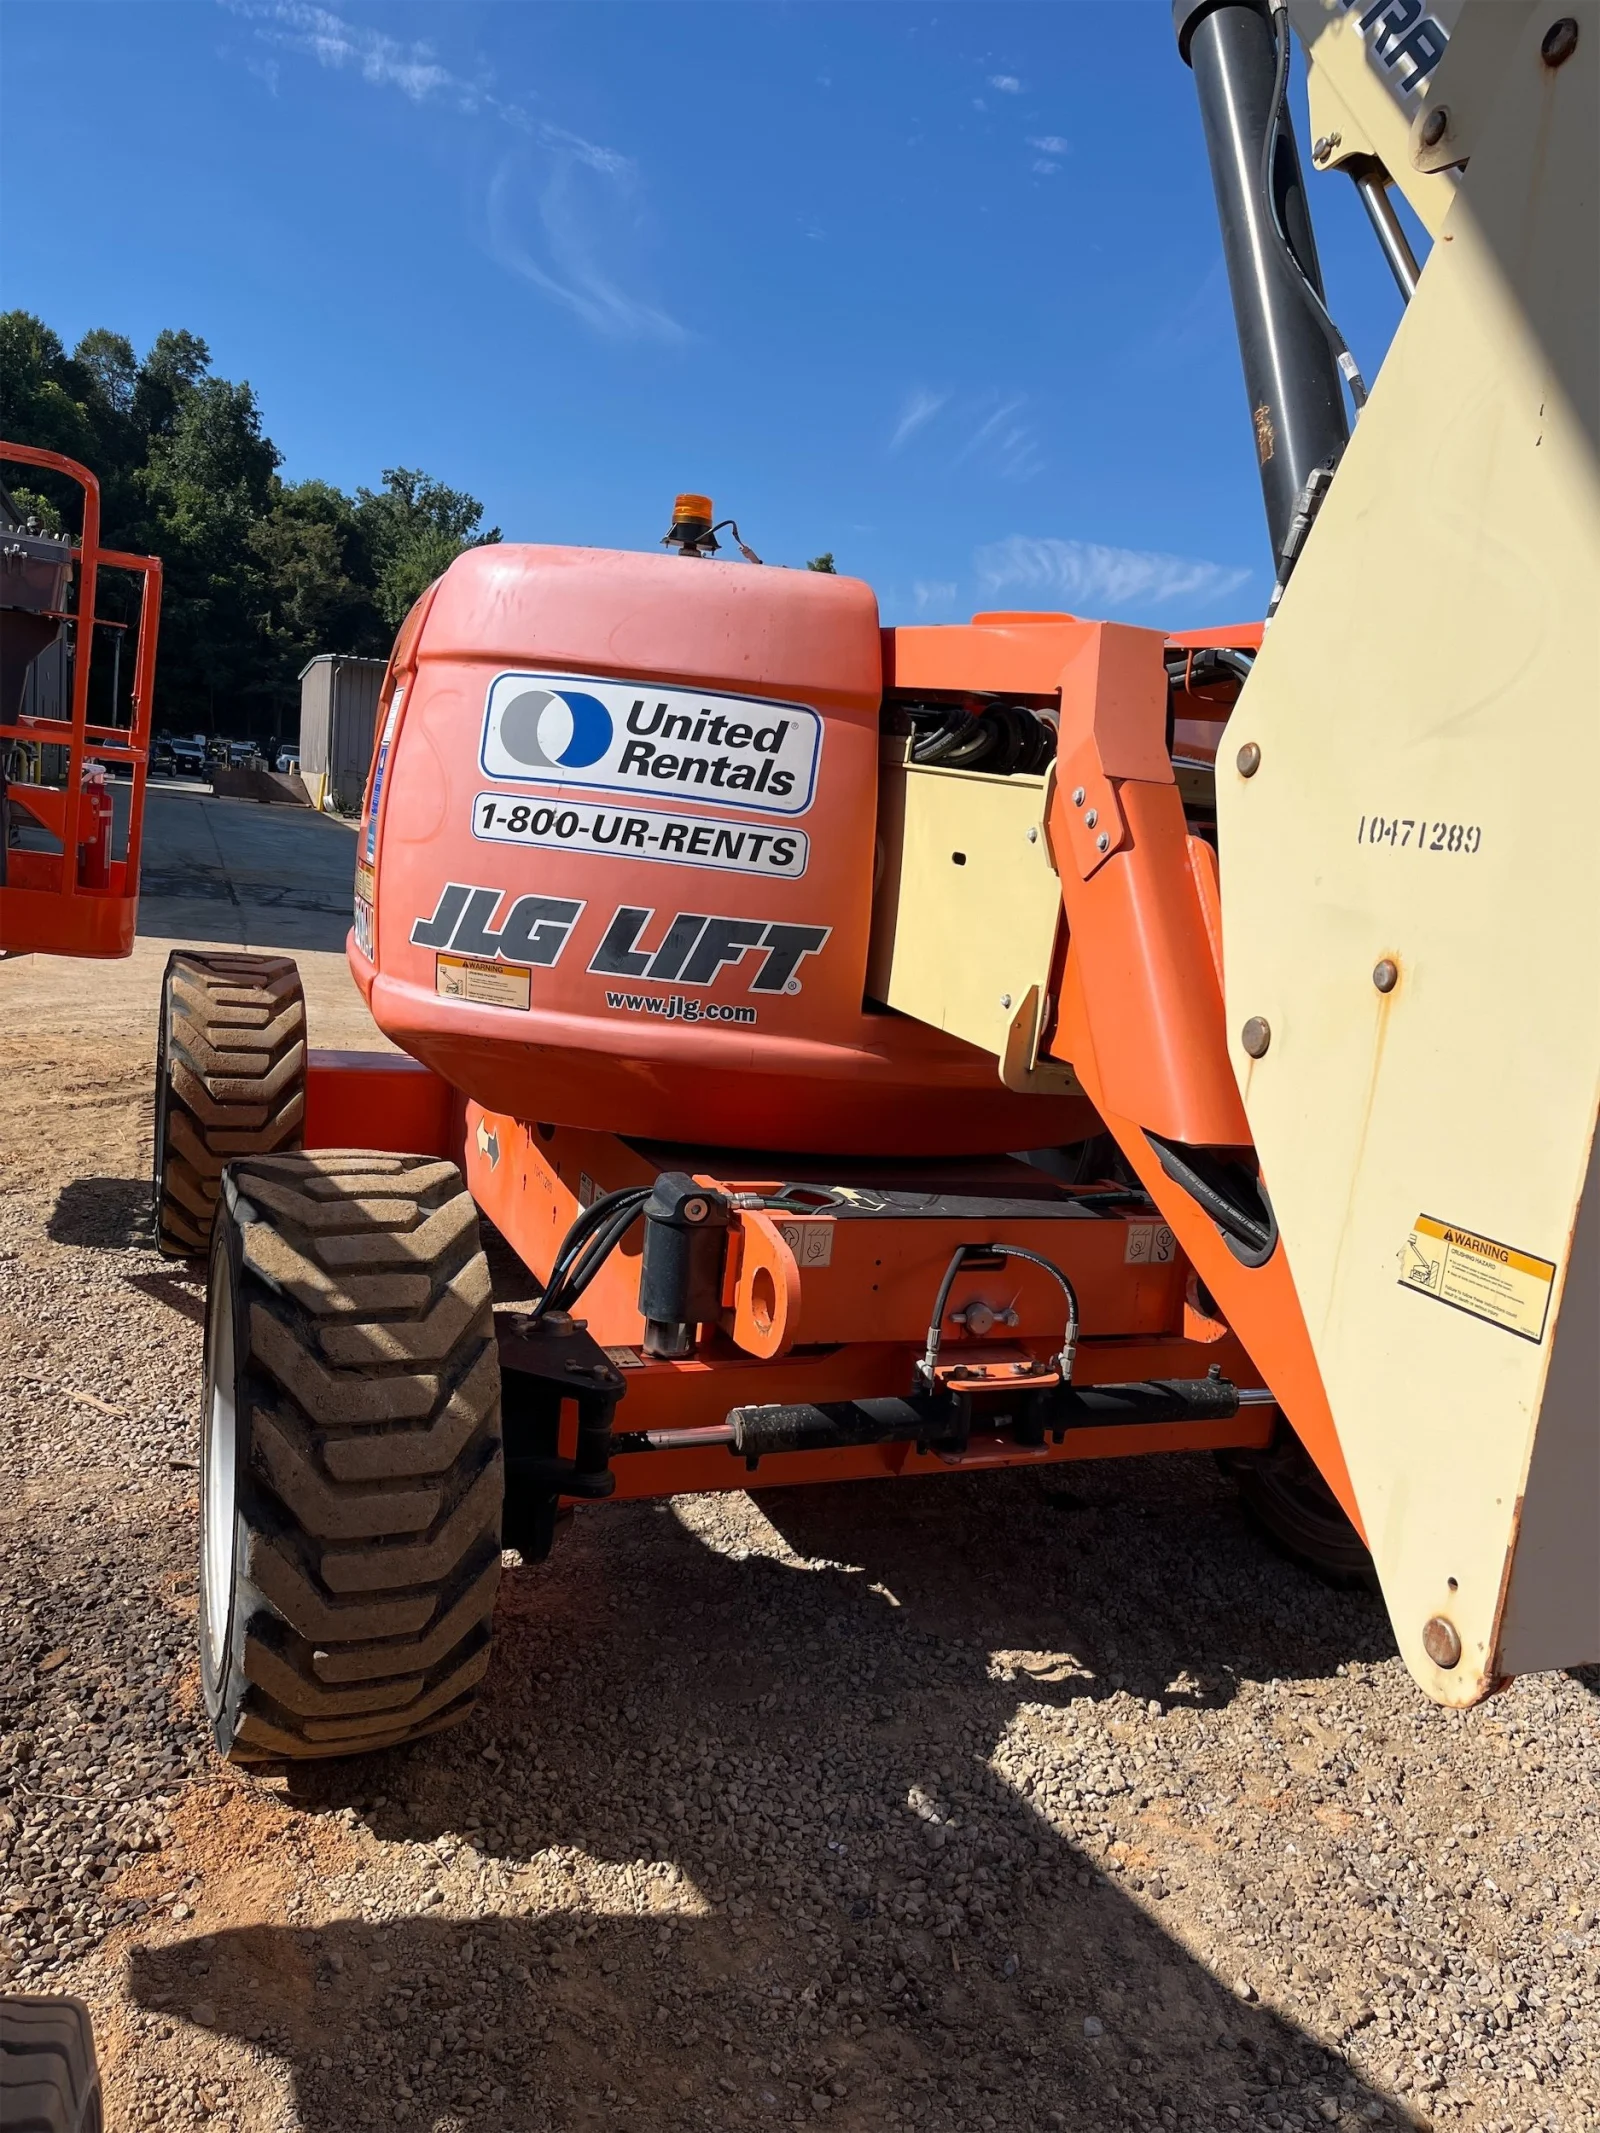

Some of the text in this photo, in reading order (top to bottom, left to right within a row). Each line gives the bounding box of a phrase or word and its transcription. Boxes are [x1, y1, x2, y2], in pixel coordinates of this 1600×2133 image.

[625, 699, 790, 755] United
[617, 740, 796, 797] Rentals
[480, 802, 798, 867] 1-800-UR-RENTS
[1358, 815, 1482, 853] 10471289
[409, 882, 587, 968] JLG
[586, 905, 833, 994] LIFT
[468, 962, 504, 974] WARNING
[605, 989, 758, 1025] www.jlg.com
[1455, 1232, 1509, 1263] WARNING
[1475, 1258, 1496, 1270] HAZARD
